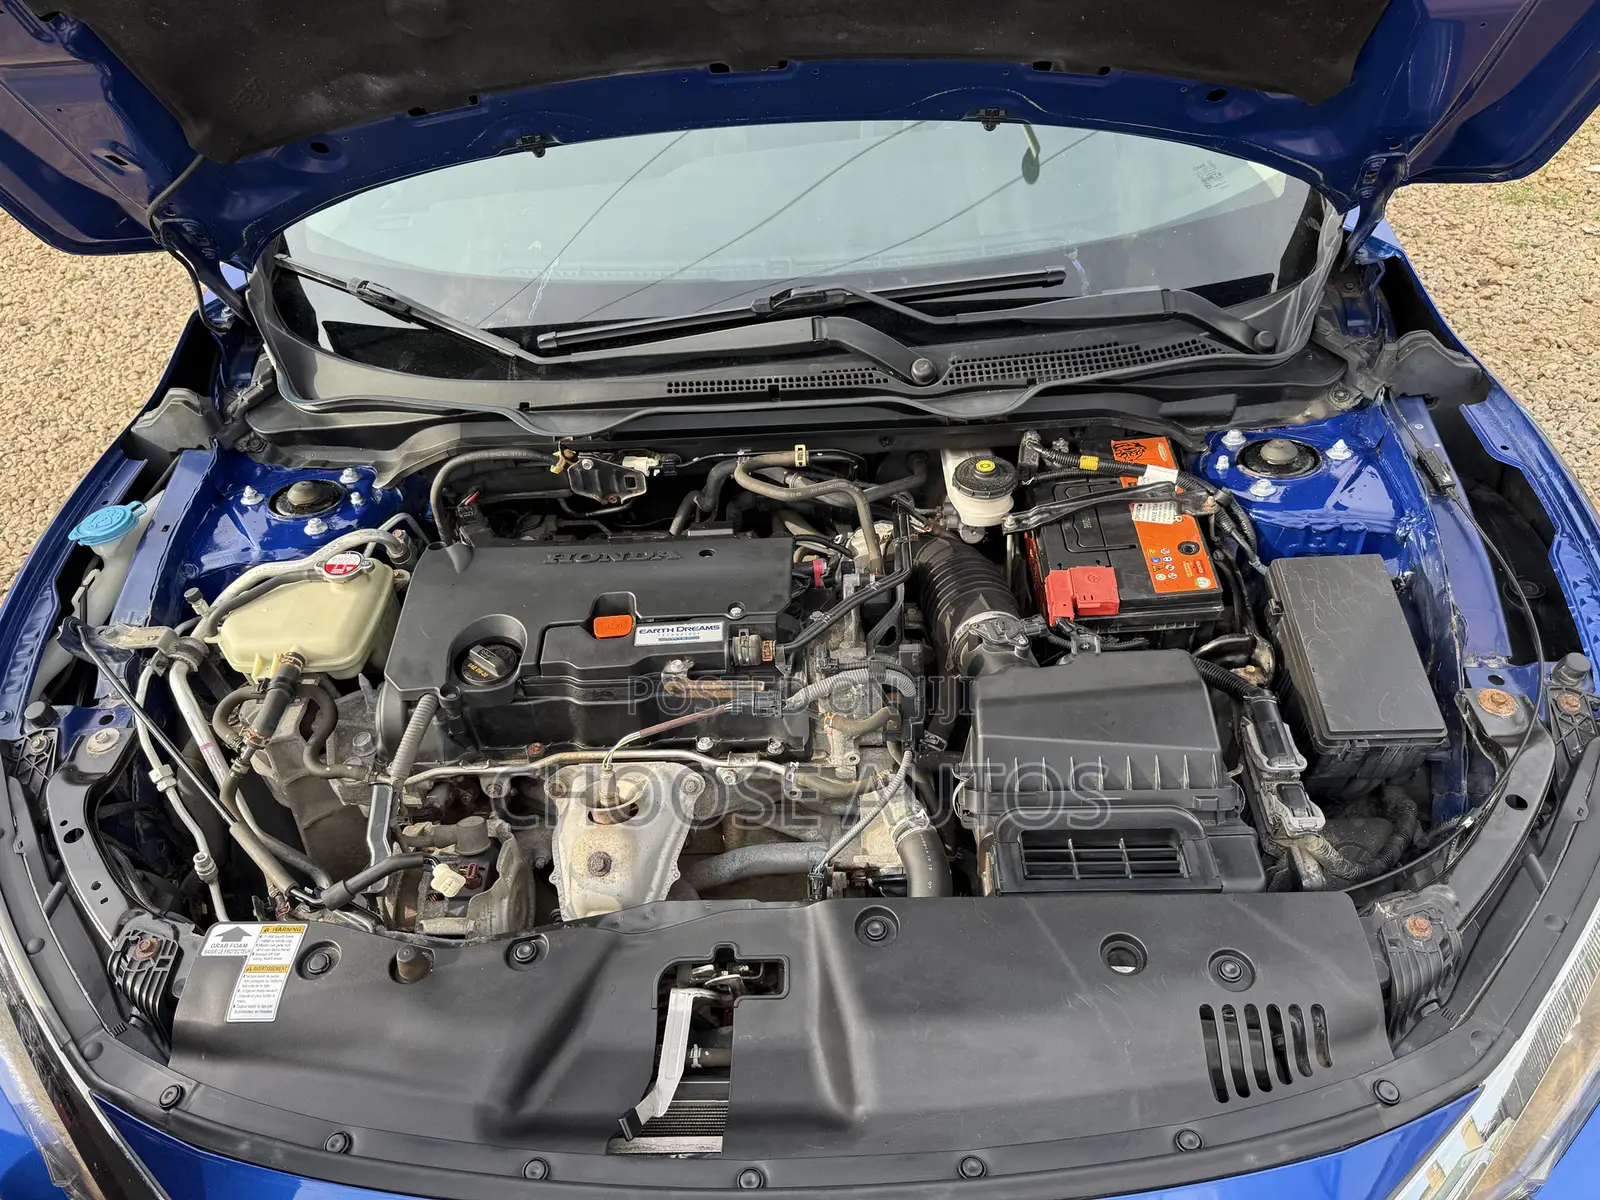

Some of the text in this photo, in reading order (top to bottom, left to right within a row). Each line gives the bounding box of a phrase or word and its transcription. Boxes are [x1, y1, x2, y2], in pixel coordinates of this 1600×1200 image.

[543, 550, 682, 564] HONDA
[639, 624, 720, 635] EARTH DREAMS
